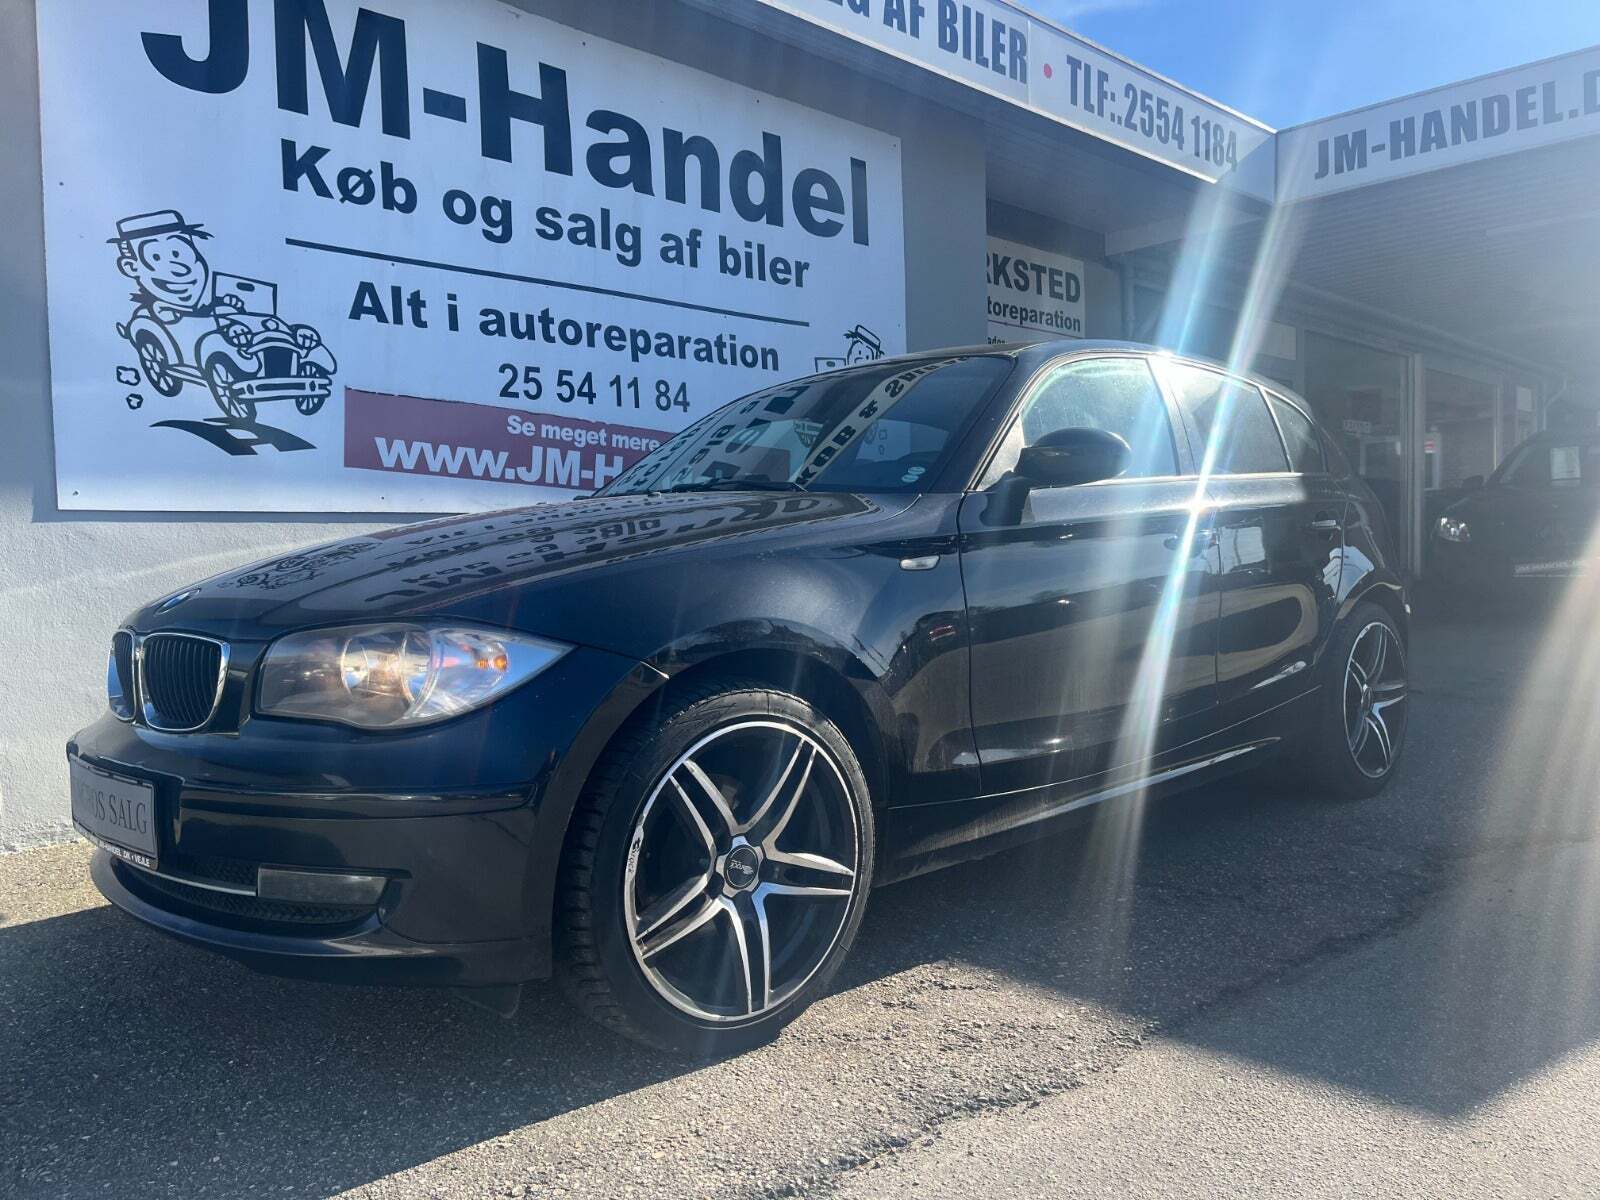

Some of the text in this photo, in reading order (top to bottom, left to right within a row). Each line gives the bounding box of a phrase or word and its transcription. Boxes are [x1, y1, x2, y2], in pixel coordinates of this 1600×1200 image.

[937, 0, 1028, 85] BILER
[141, 0, 870, 247] JM-Handel
[1190, 115, 1238, 173] 1184
[280, 137, 810, 288] Køb og salg af biler
[986, 251, 1081, 304] KSTED
[347, 280, 779, 372] Alt i autoreparation
[498, 362, 691, 413] 25 54 11 84
[506, 414, 661, 453] Se meget mere
[109, 793, 148, 834] SALG
